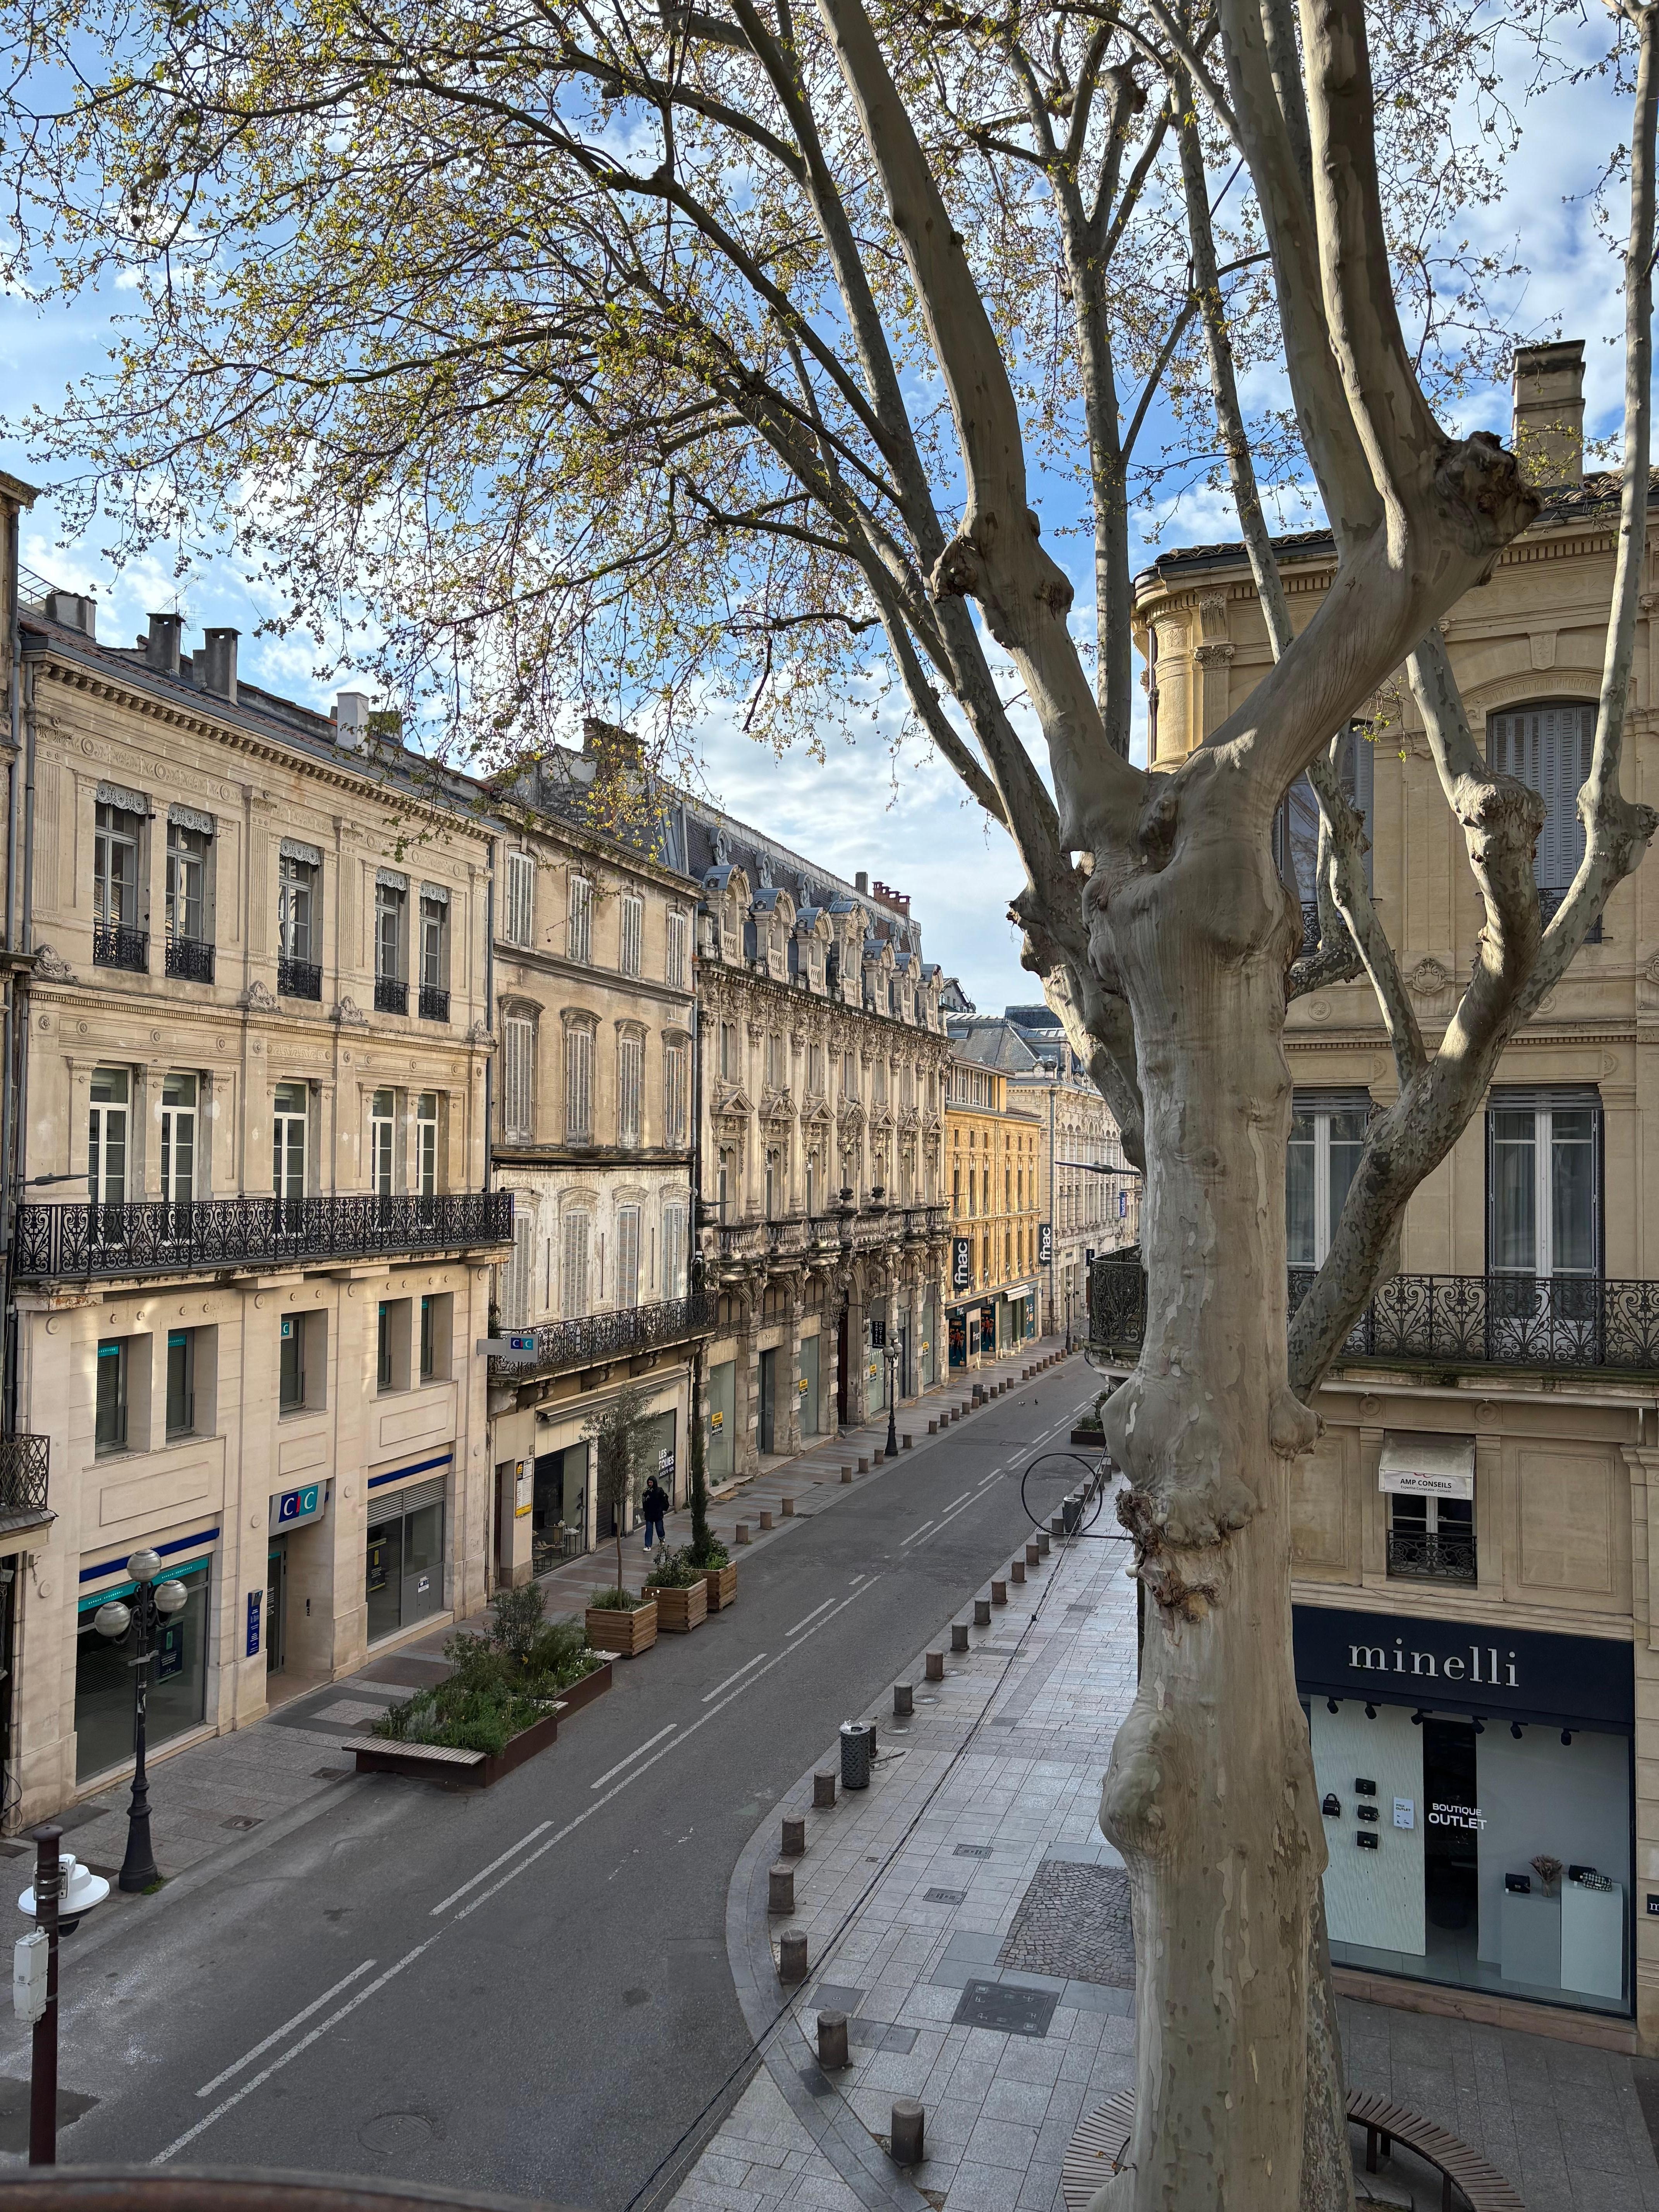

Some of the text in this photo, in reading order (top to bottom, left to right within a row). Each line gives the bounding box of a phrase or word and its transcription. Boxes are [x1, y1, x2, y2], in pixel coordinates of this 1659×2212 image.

[1039, 1227, 1051, 1261] fnac
[954, 1242, 968, 1285] fnac
[513, 1340, 531, 1348] CIC
[659, 1455, 674, 1470] FOLIES
[1418, 1480, 1452, 1489] CONSEILS
[283, 1491, 314, 1516] CIC
[1348, 1638, 1519, 1687] minelli
[1432, 1803, 1482, 1817] BOUTIQUE
[1428, 1812, 1487, 1830] OUTLET
